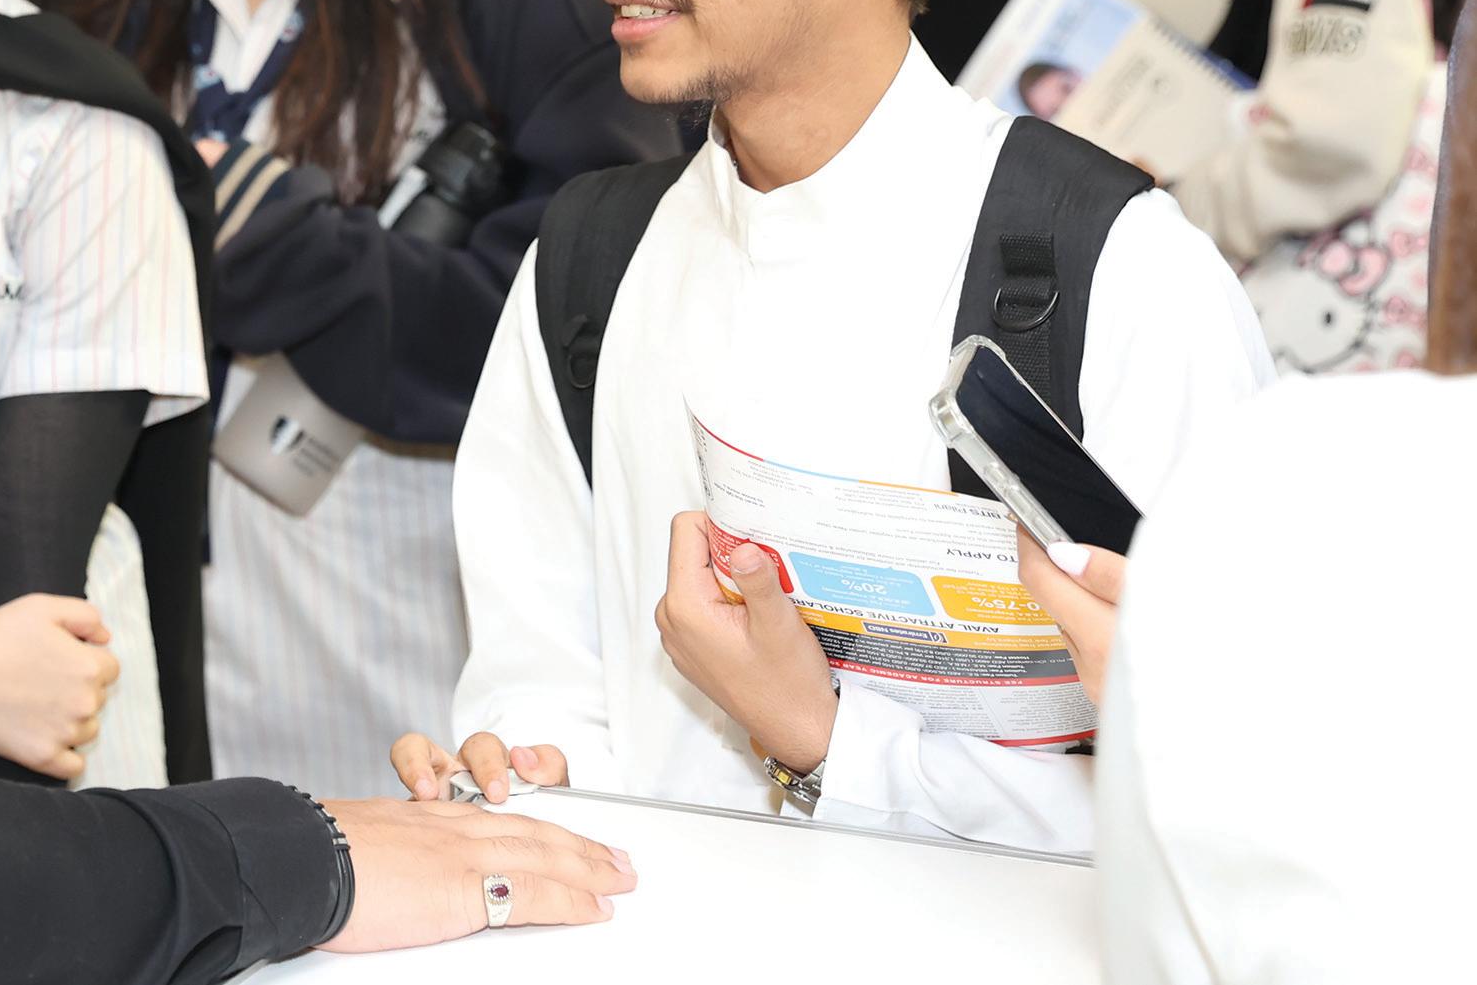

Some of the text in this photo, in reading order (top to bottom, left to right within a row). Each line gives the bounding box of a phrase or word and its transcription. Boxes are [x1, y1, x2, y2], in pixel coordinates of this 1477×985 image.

[933, 503, 968, 514] Pilani
[969, 508, 1001, 520] BITS
[946, 548, 1019, 563] TO APPLY
[841, 579, 888, 595] 20%
[866, 611, 954, 630] ATTRACTIVE
[889, 628, 929, 639] Emirates
[958, 624, 999, 633] AVAIL
[843, 663, 868, 672] YEAR
[869, 668, 918, 680] ACADEMIC
